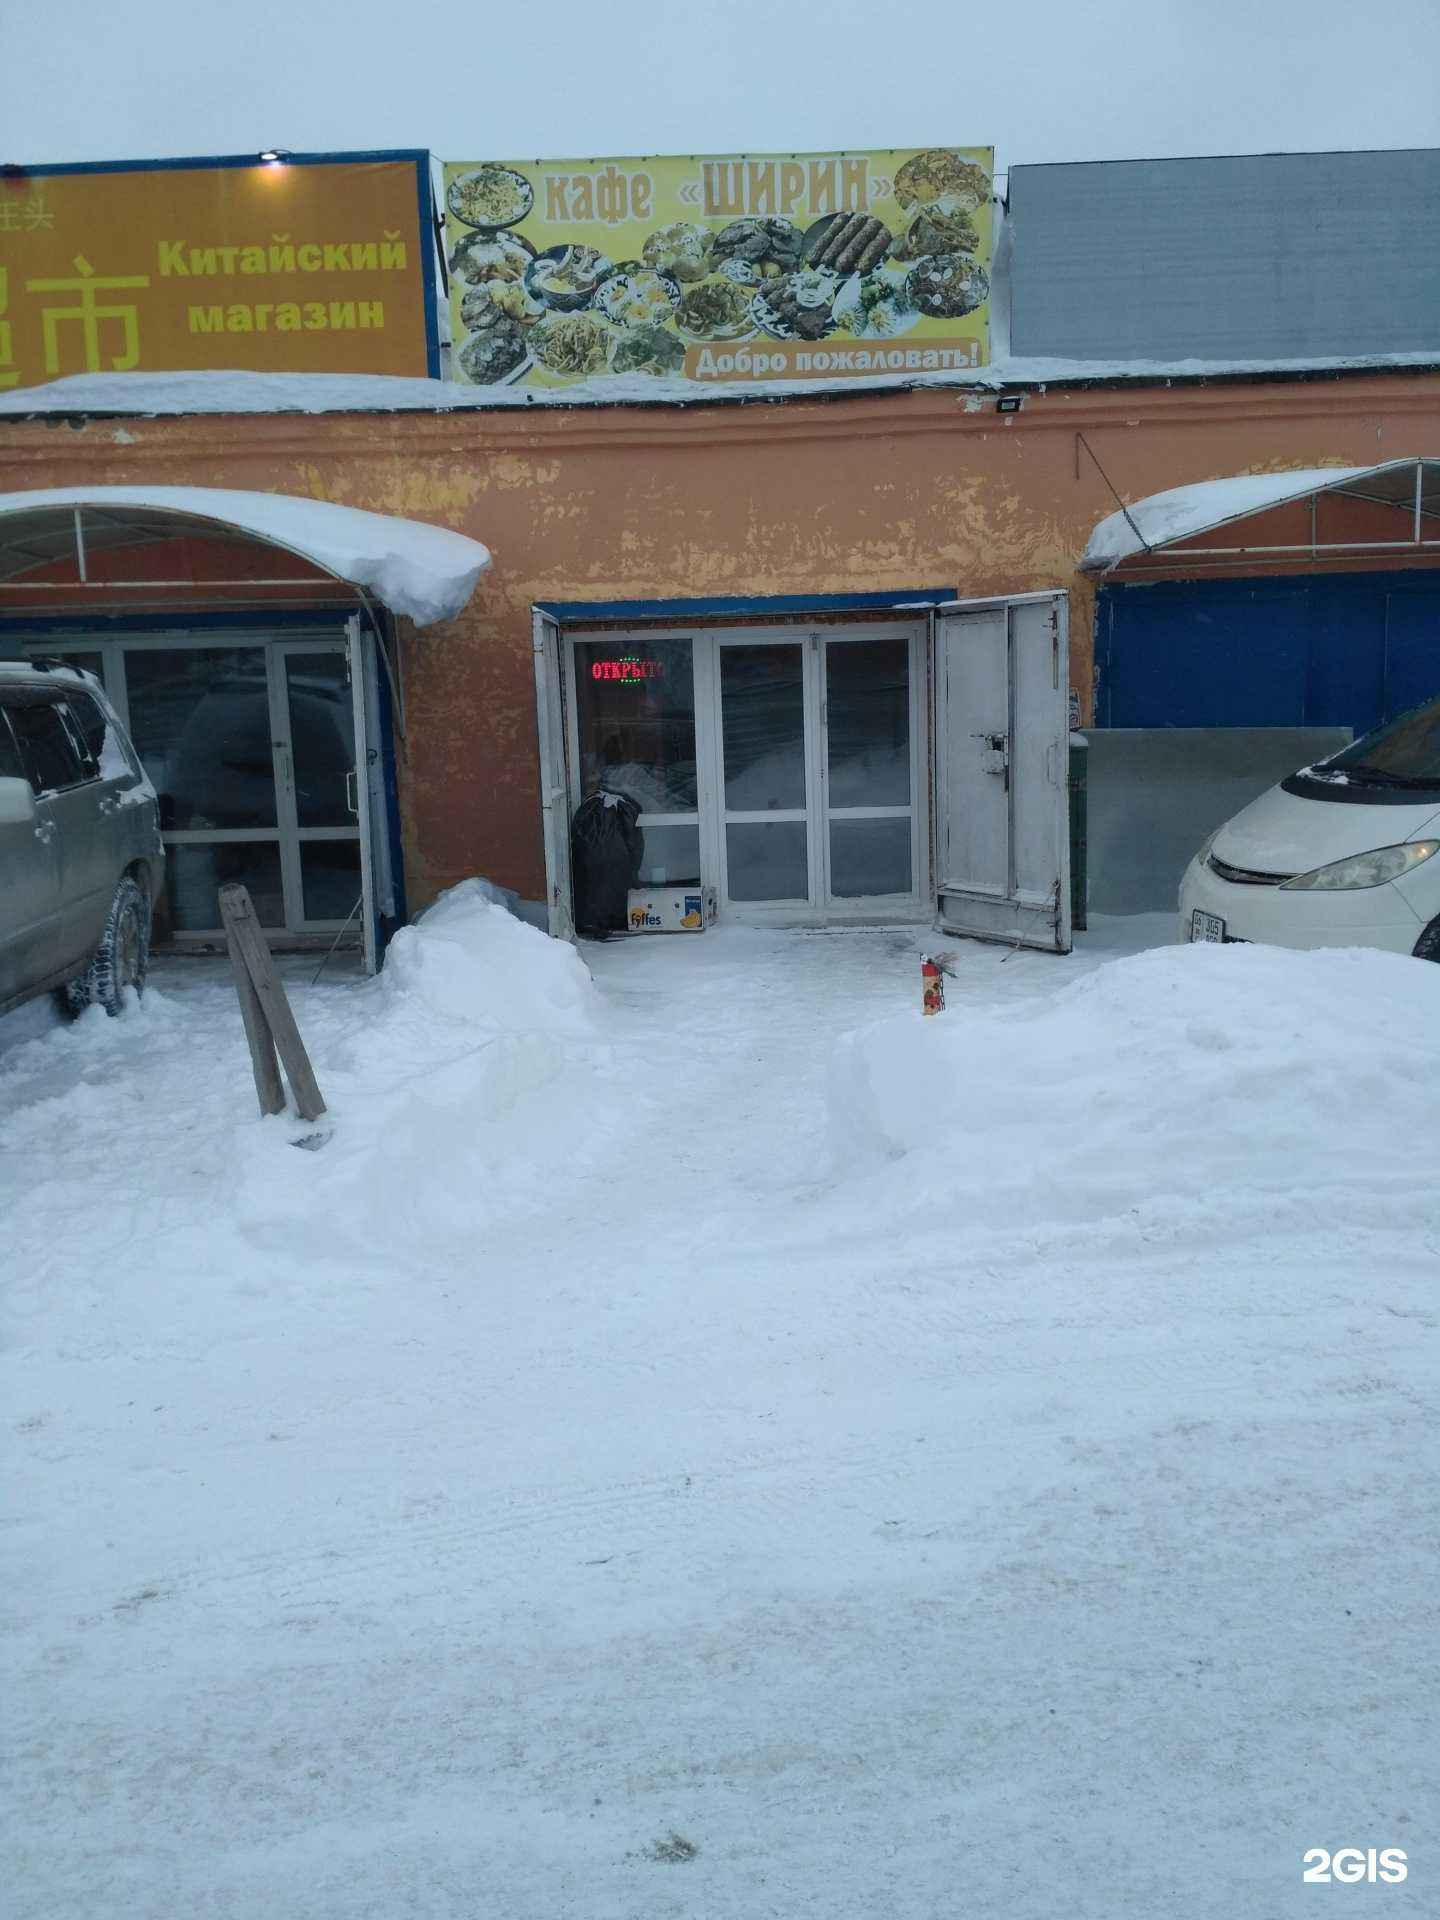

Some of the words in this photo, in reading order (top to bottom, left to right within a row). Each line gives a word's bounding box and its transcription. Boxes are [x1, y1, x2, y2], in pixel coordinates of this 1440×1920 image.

[545, 166, 652, 224] кафе
[158, 230, 407, 277] Китайский
[188, 301, 385, 333] магазин
[696, 348, 787, 377] Добро
[795, 342, 978, 371] пожаловать!
